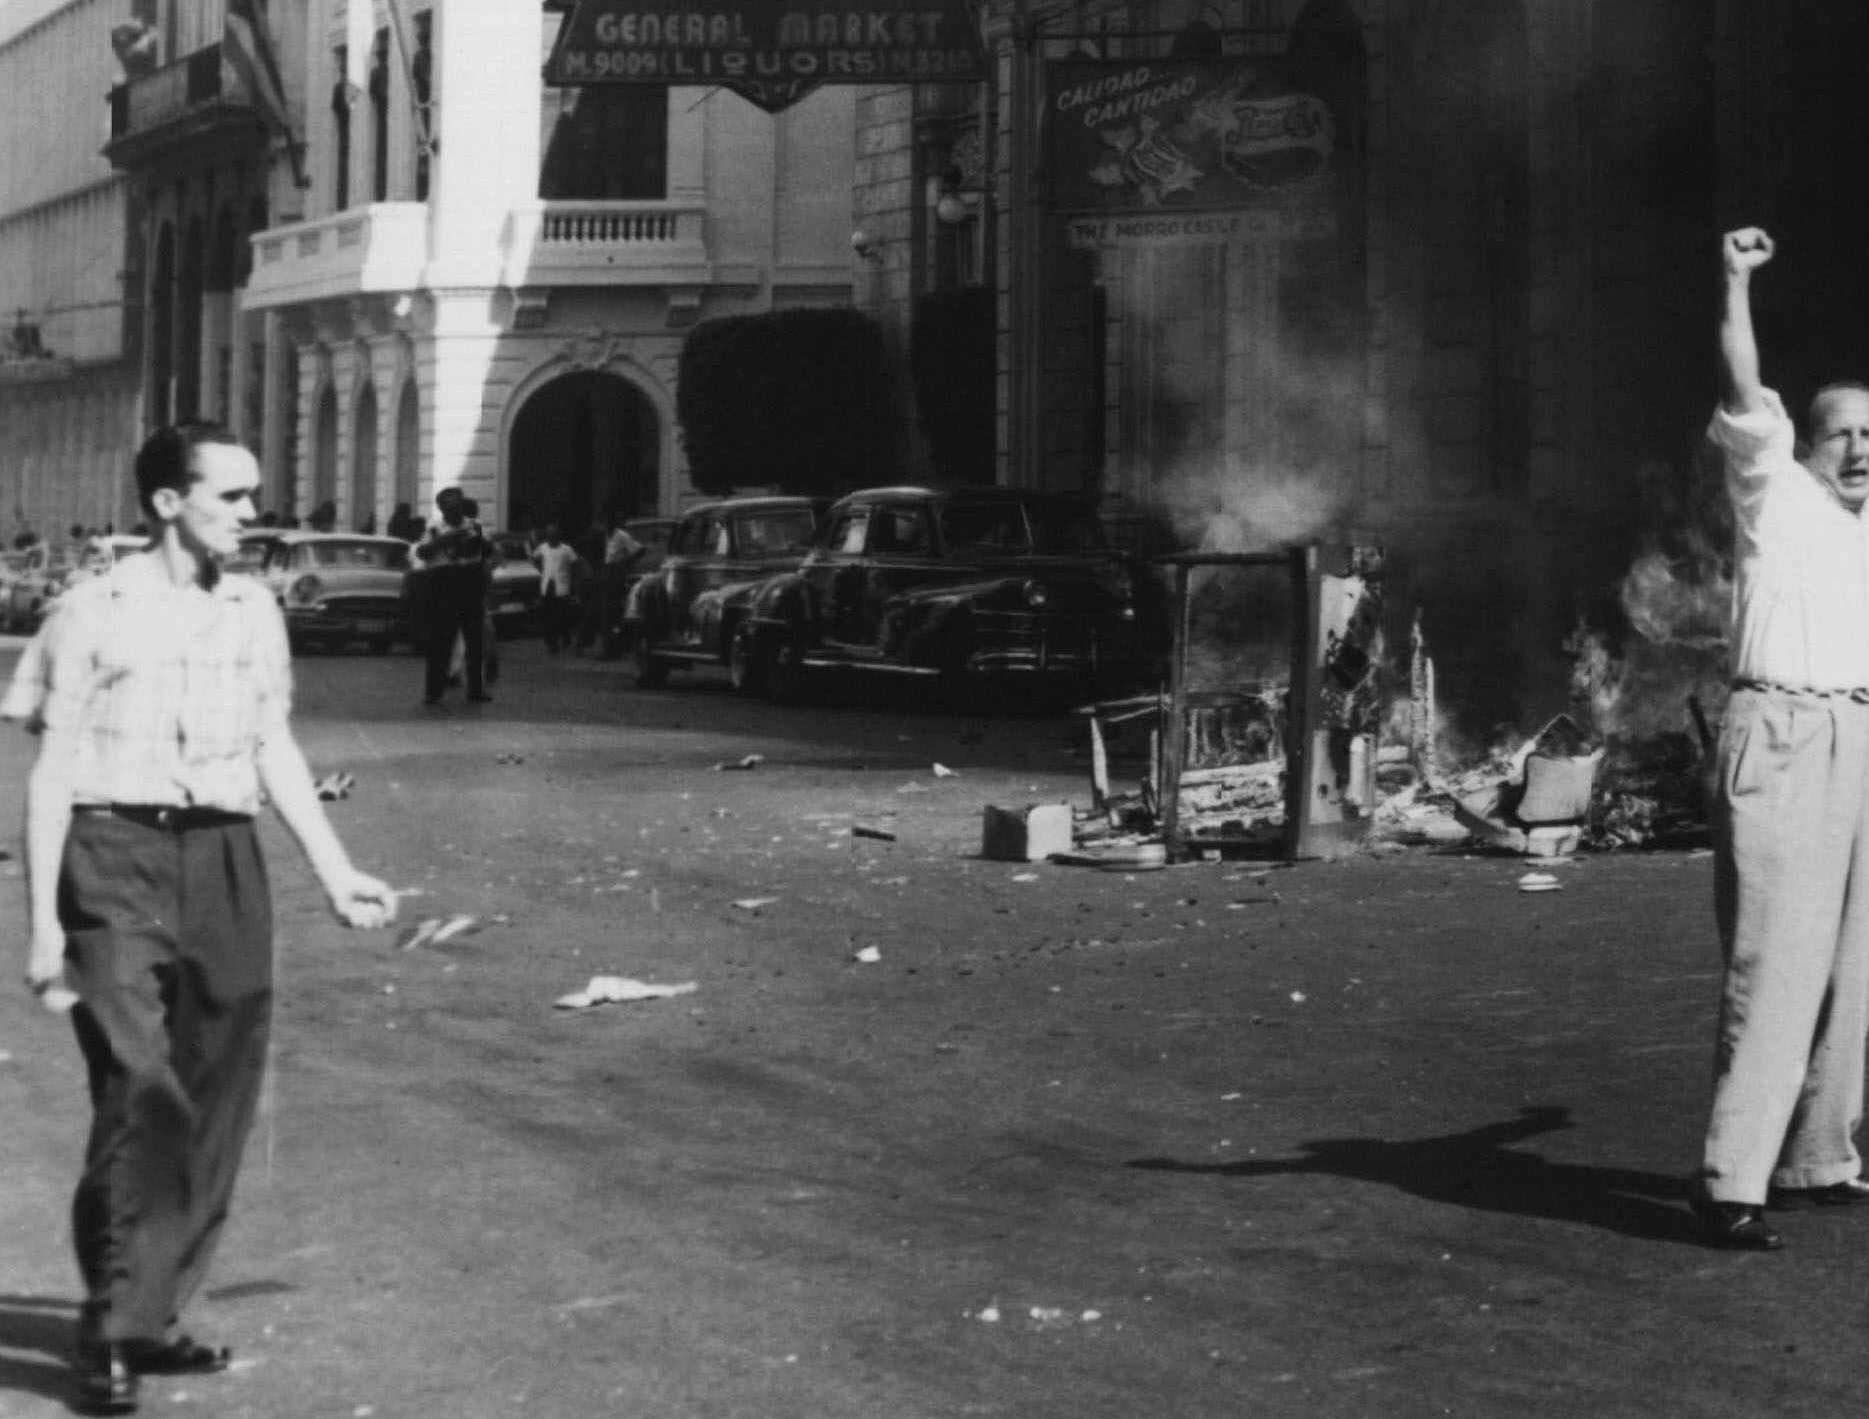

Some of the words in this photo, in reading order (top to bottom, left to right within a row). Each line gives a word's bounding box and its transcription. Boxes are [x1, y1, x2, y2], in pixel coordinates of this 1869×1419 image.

[596, 13, 750, 46] GENERAL
[779, 11, 944, 45] MARKET
[1083, 74, 1197, 128] CANTIDAD
